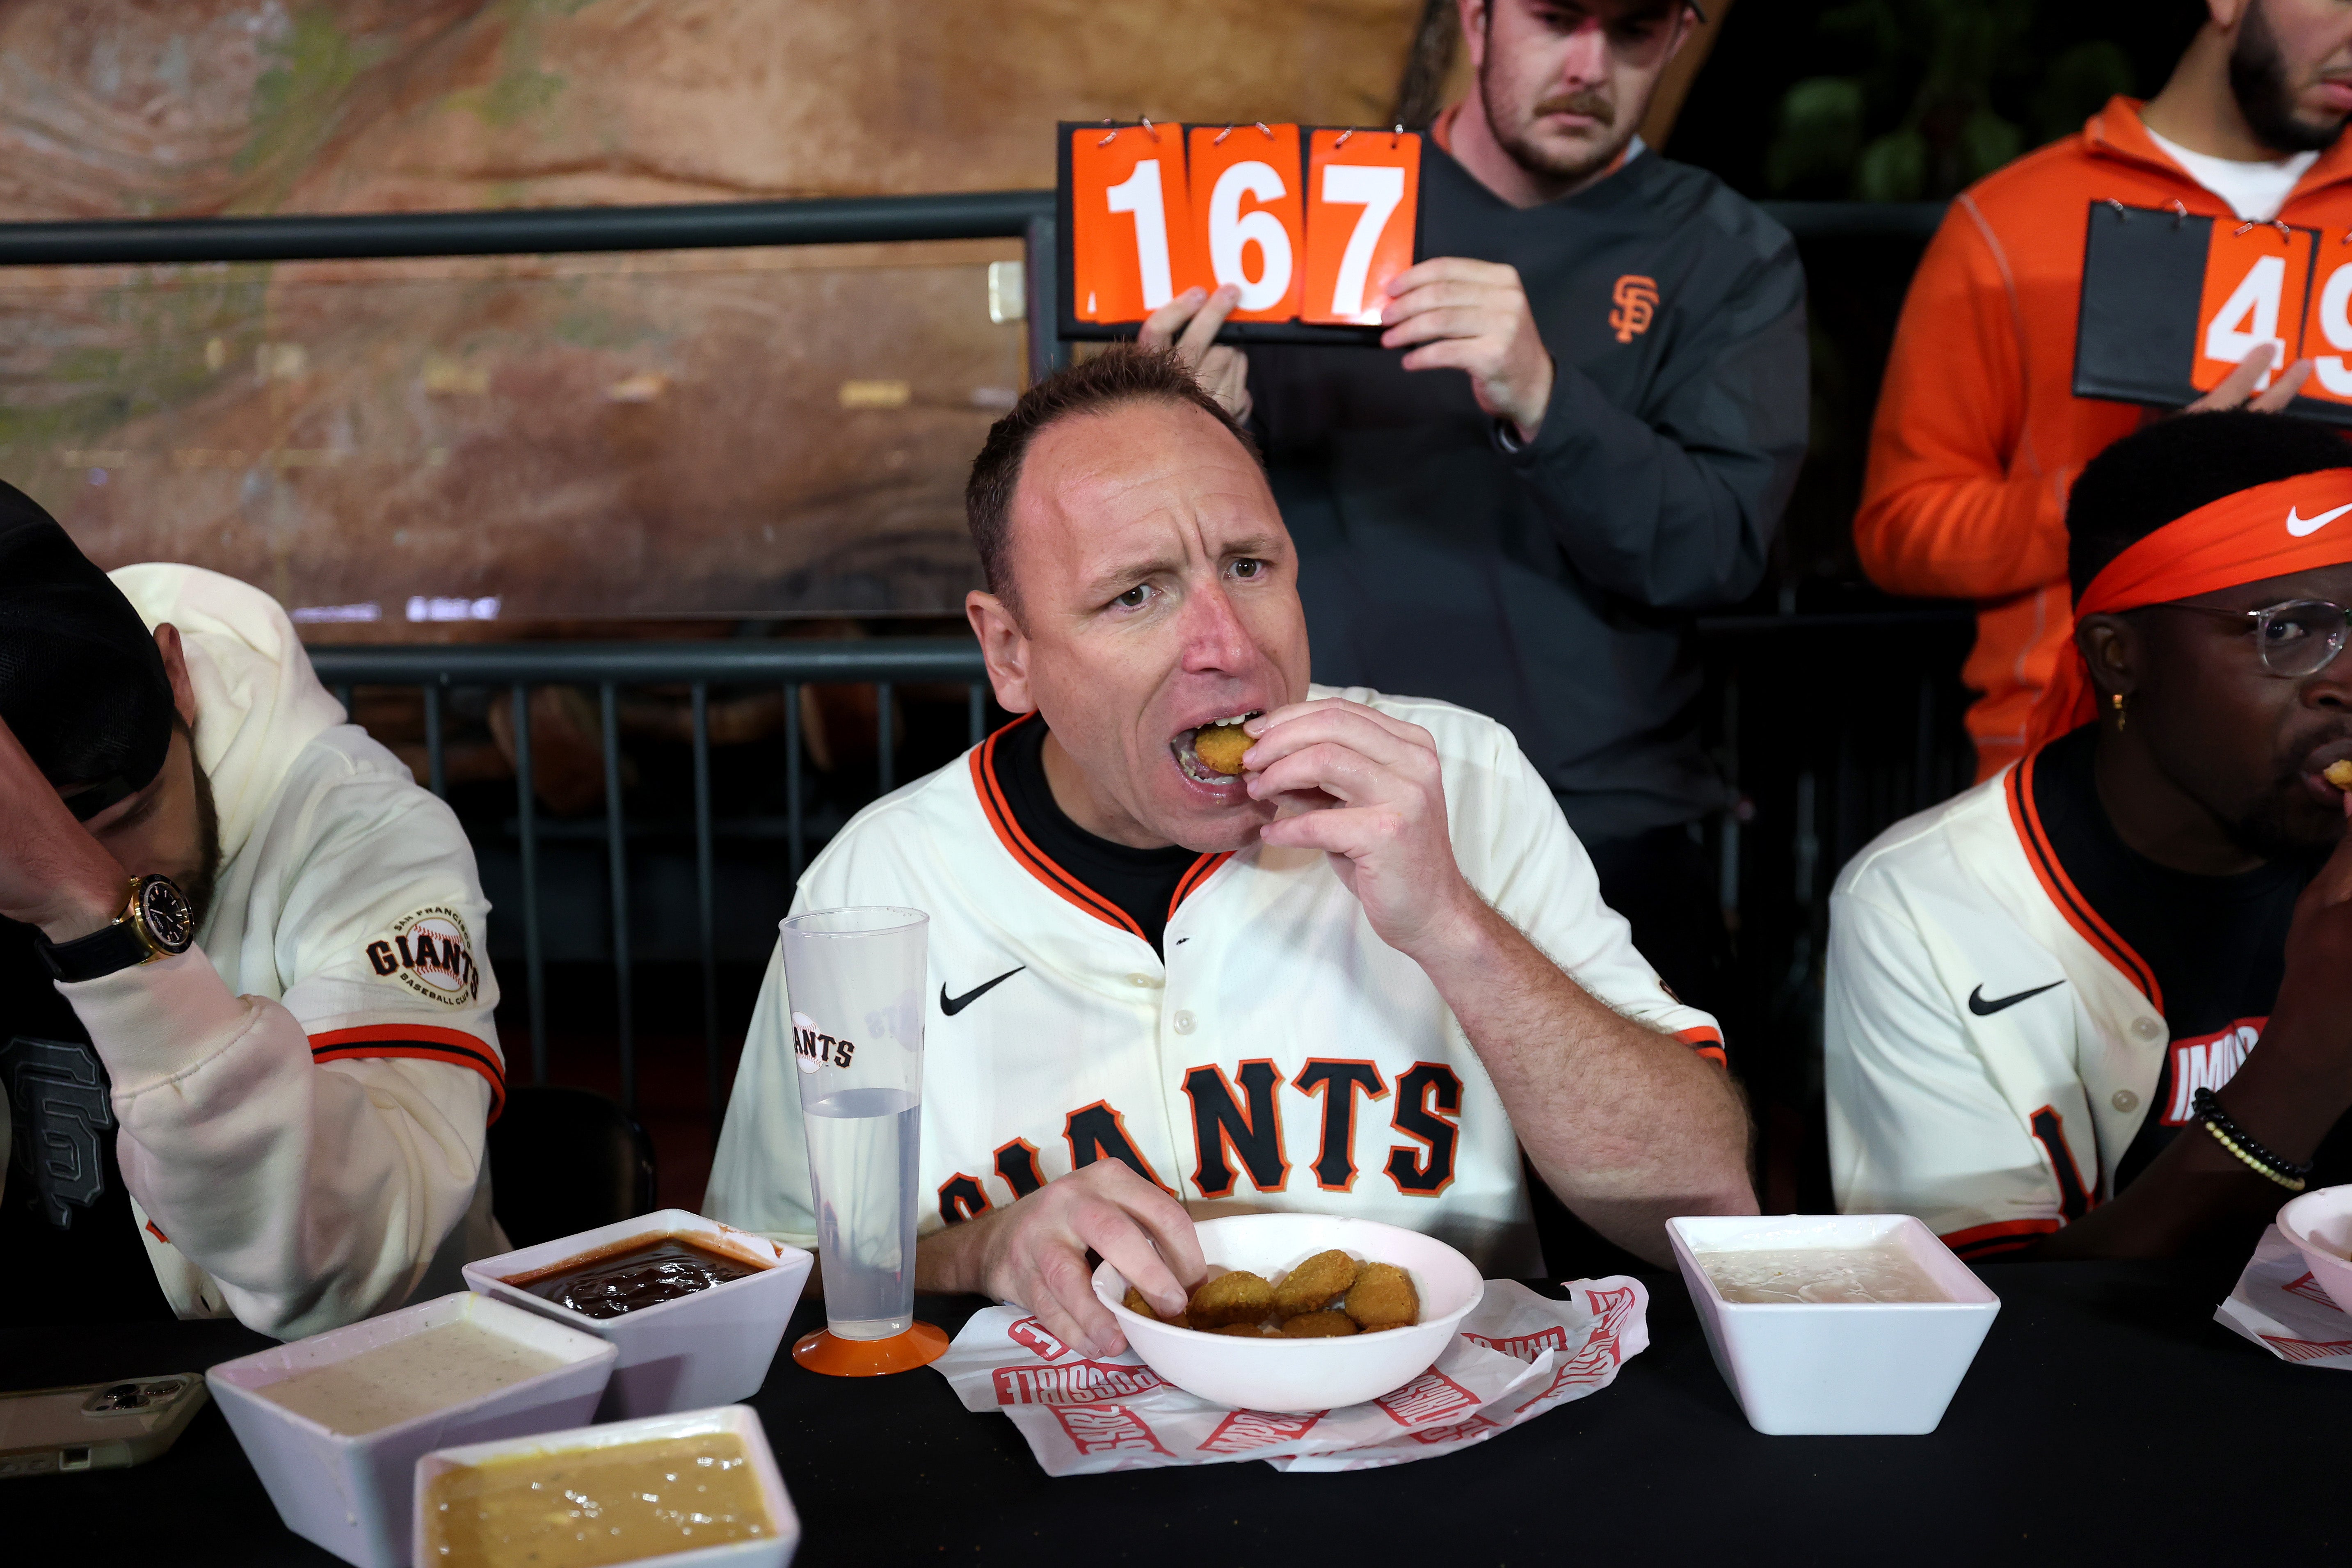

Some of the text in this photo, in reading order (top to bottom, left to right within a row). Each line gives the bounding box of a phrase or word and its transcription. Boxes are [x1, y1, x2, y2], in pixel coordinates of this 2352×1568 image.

[1106, 158, 1405, 315] 167
[1608, 274, 1660, 344] SF
[394, 906, 470, 949] SAN FRANCISCO
[365, 935, 479, 1001] GIANTS
[399, 972, 469, 1006] BASEBALL CLUB
